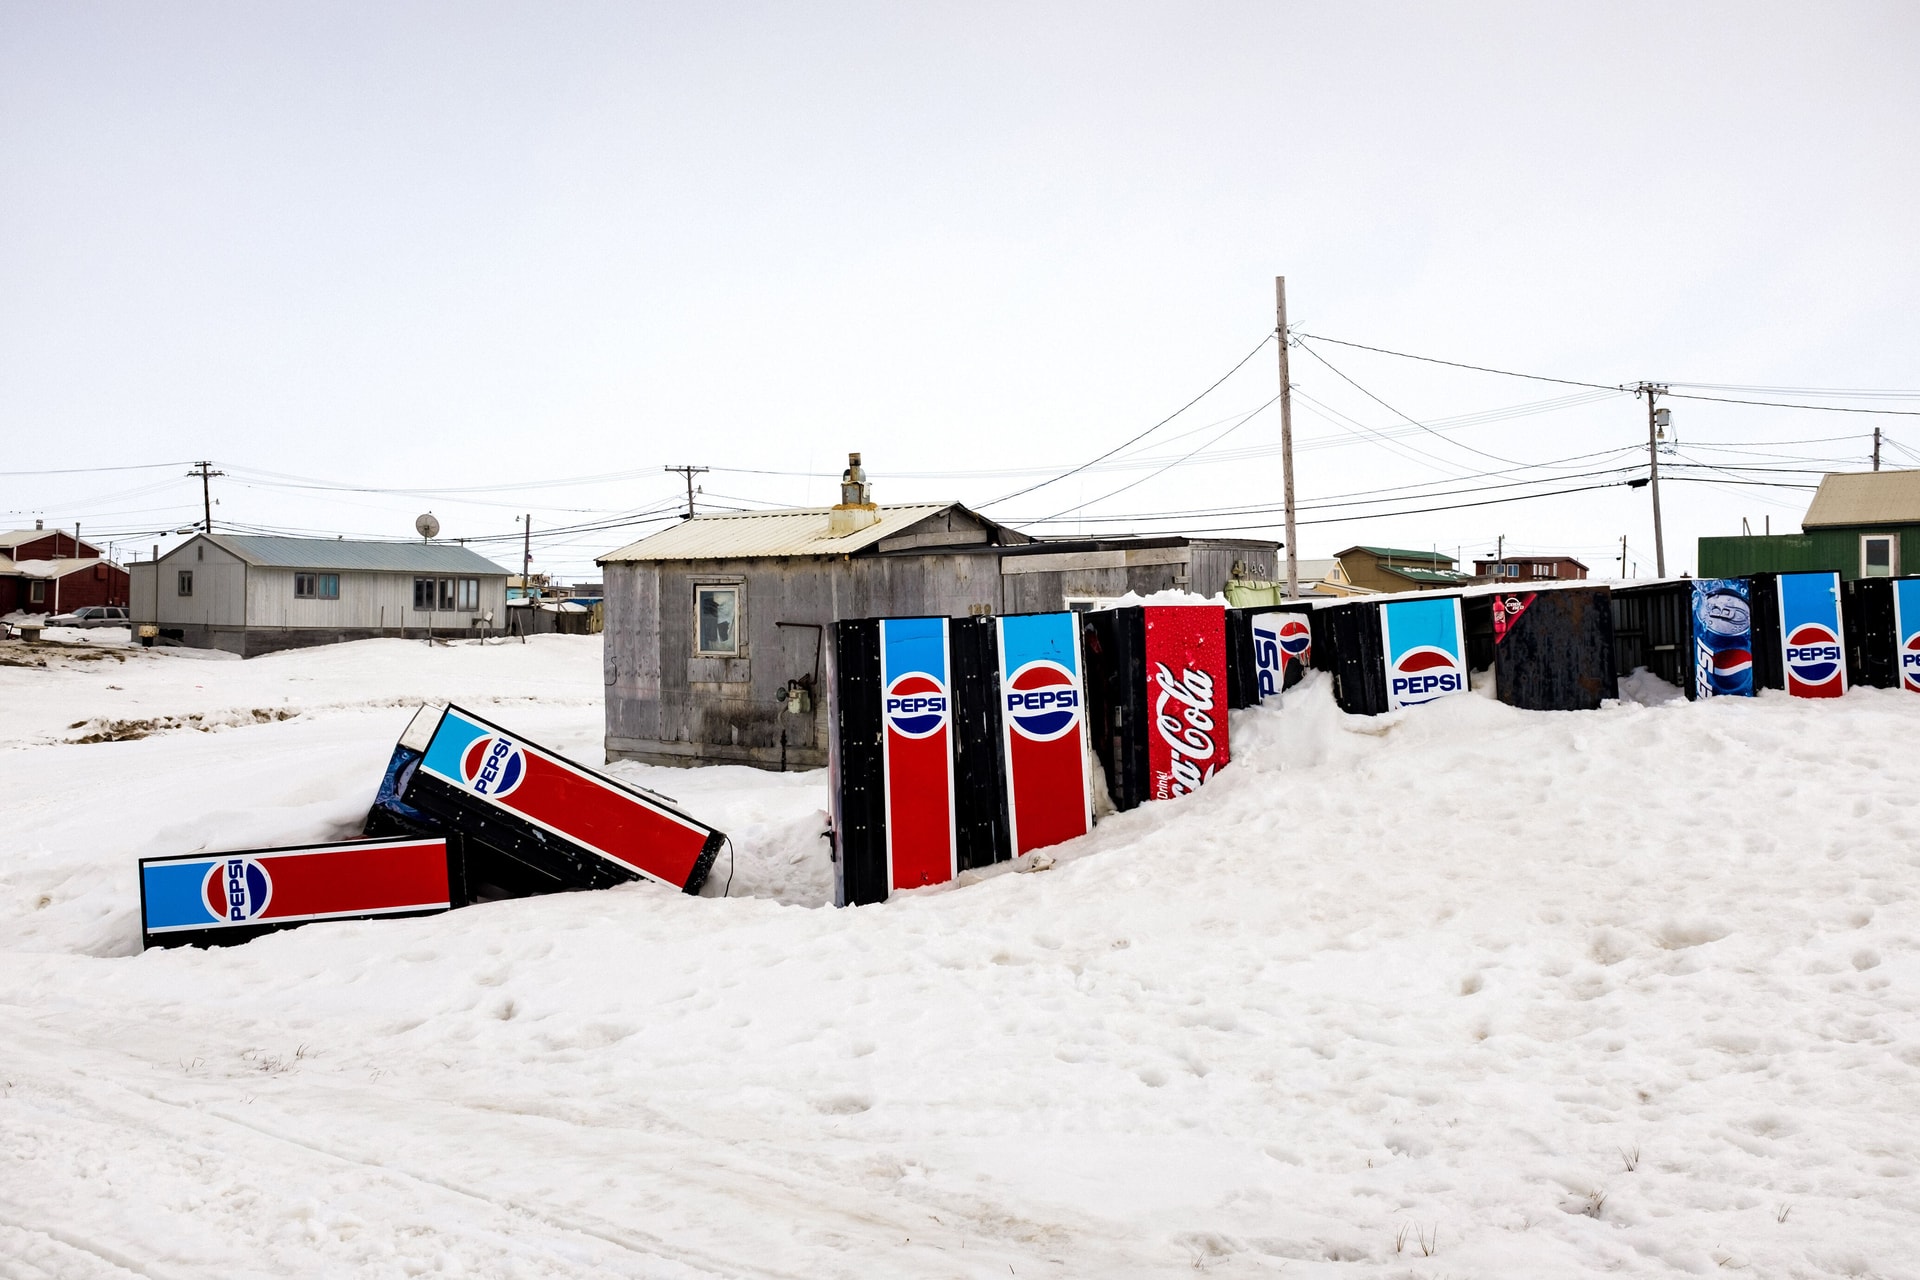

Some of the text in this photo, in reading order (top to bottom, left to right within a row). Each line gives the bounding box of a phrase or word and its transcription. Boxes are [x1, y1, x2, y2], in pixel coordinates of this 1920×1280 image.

[1254, 627, 1280, 699] PSI
[1696, 636, 1714, 700] EPSI
[1787, 646, 1841, 662] PEPSI
[1007, 689, 1079, 711] PEPSI
[1392, 673, 1462, 696] PEPSI
[886, 697, 947, 714] PEPSI
[474, 737, 512, 795] PEPSI
[228, 859, 245, 922] PEPSI
